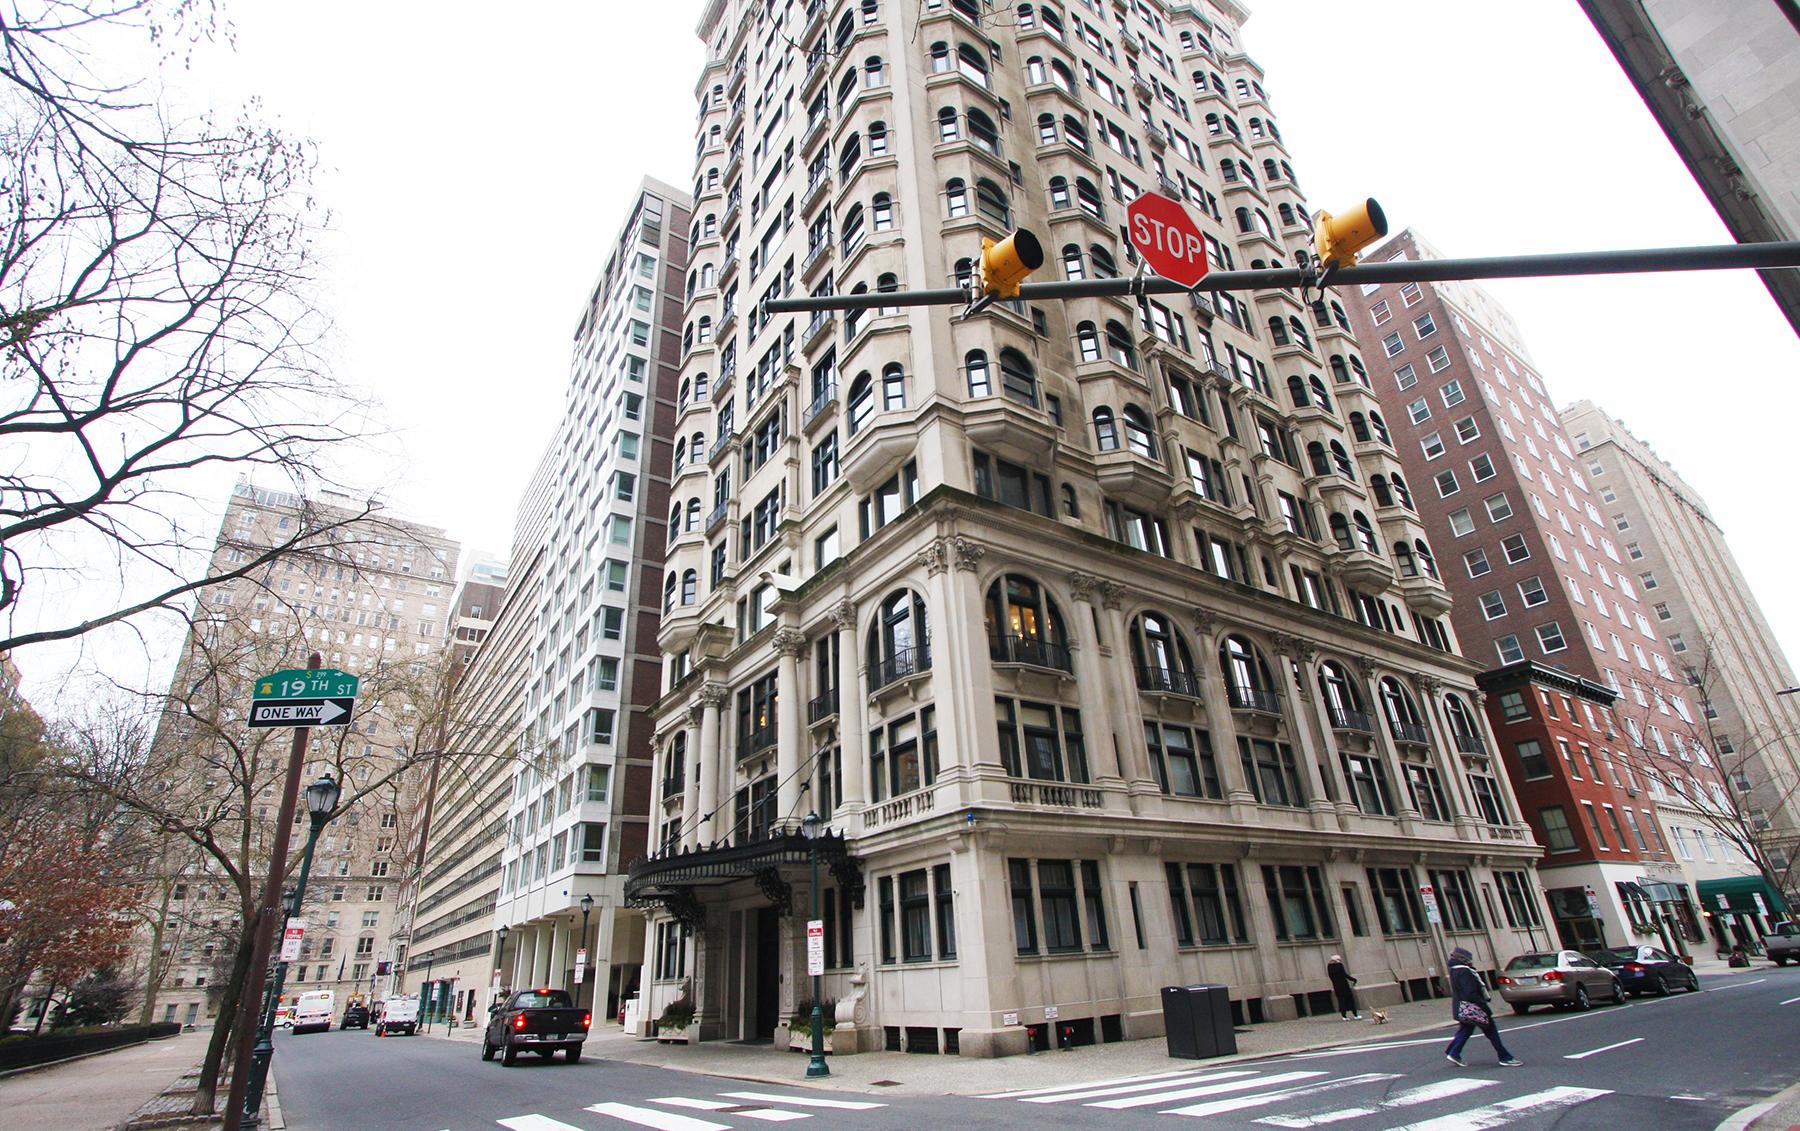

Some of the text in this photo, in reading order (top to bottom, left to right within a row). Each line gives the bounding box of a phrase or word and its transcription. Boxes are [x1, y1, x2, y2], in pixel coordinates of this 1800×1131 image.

[1134, 213, 1201, 264] STOP
[306, 671, 312, 679] S
[281, 680, 352, 696] 19TH ST
[261, 707, 322, 718] ONE WAY
